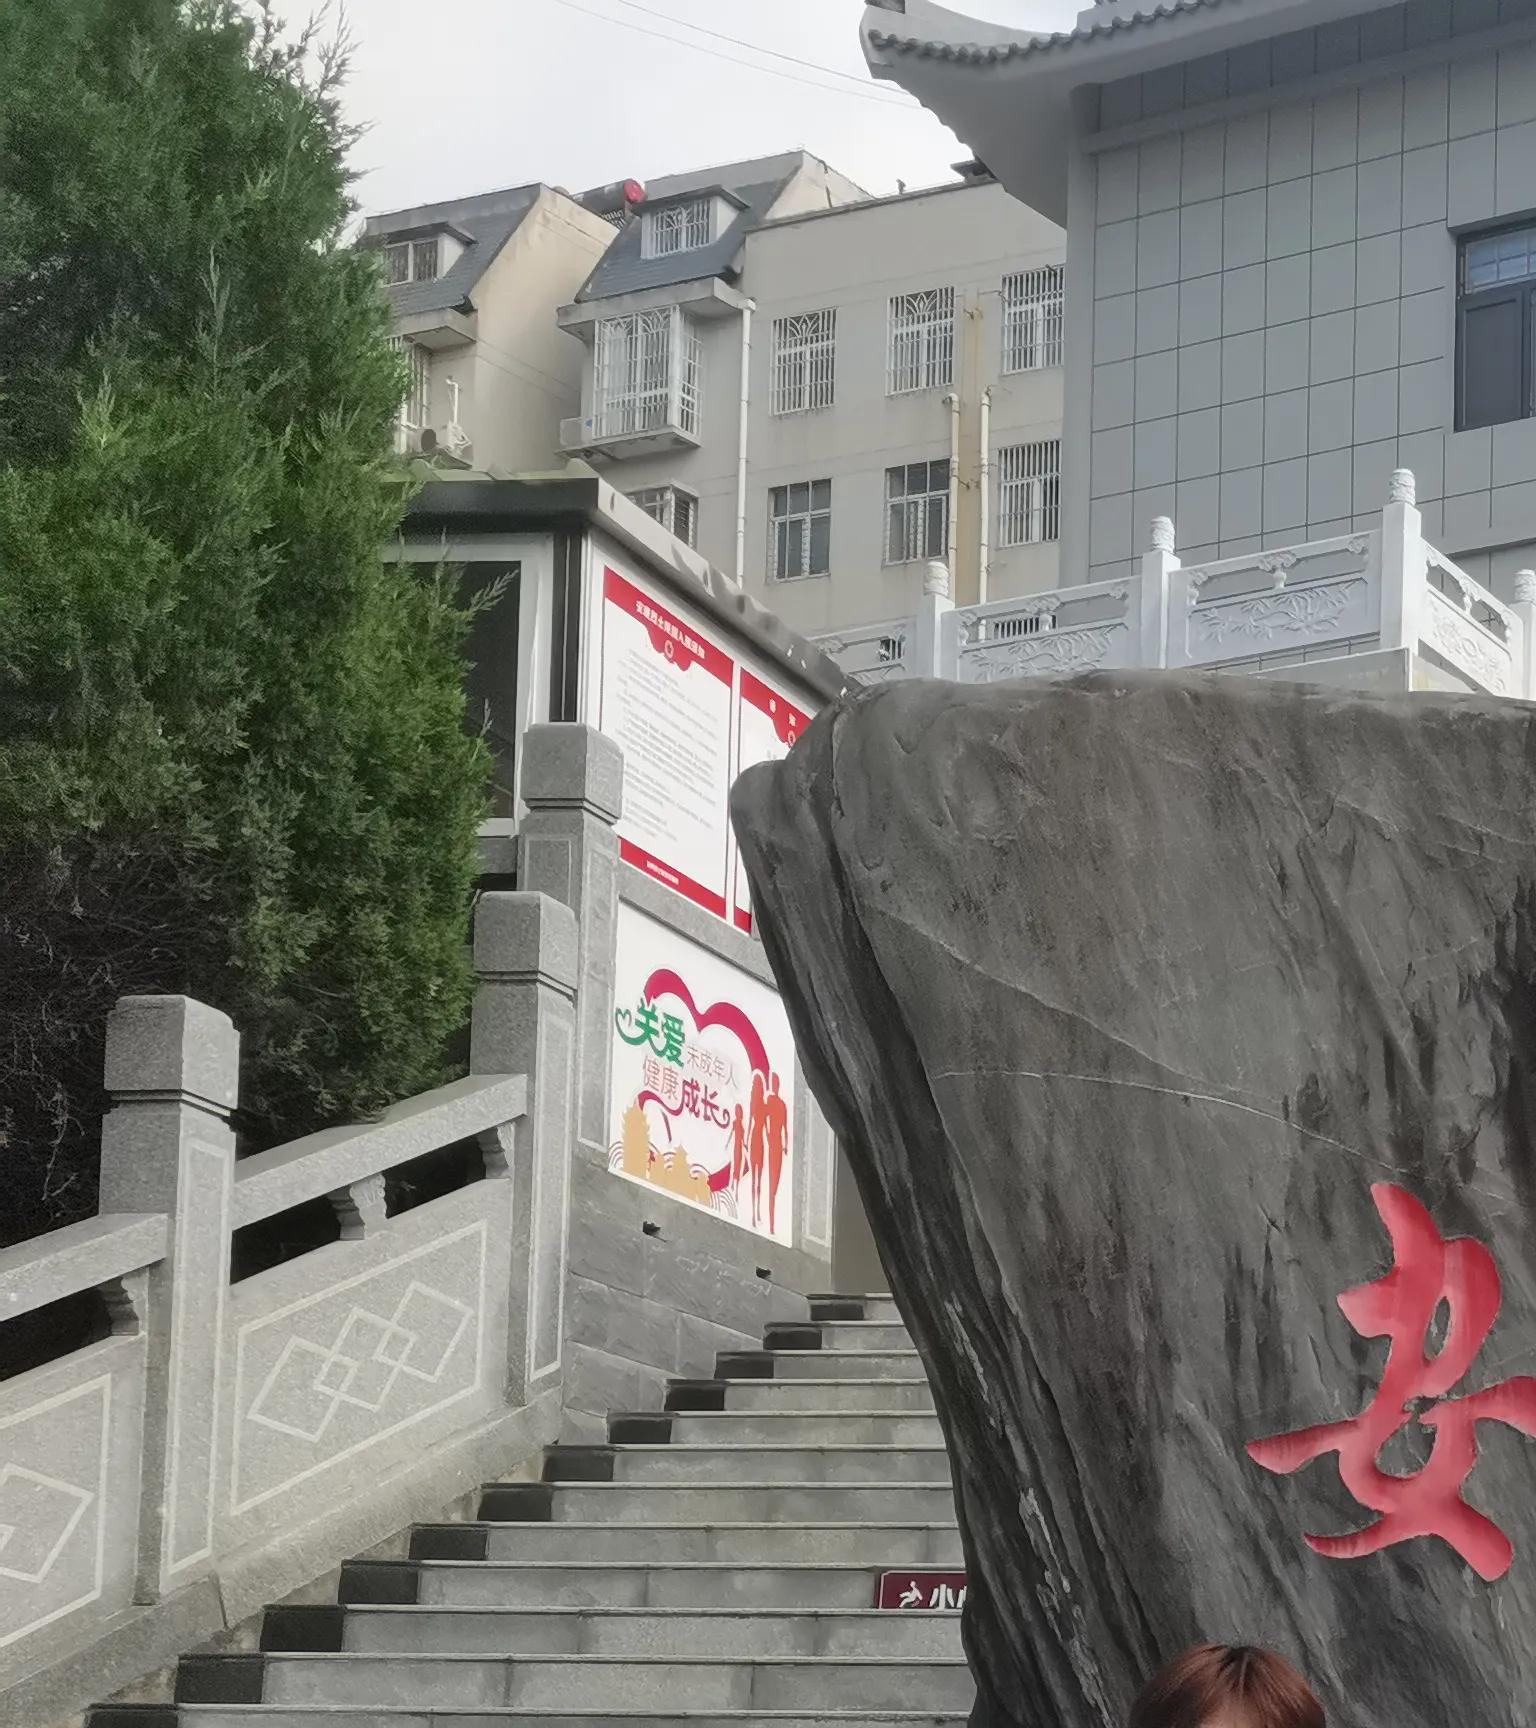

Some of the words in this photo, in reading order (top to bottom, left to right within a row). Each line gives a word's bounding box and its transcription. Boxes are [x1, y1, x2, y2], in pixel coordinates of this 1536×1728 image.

[616, 997, 685, 1068] 关爱
[687, 1044, 738, 1089] 未成年人
[642, 1055, 680, 1101] 健康
[682, 1078, 730, 1129] 成长
